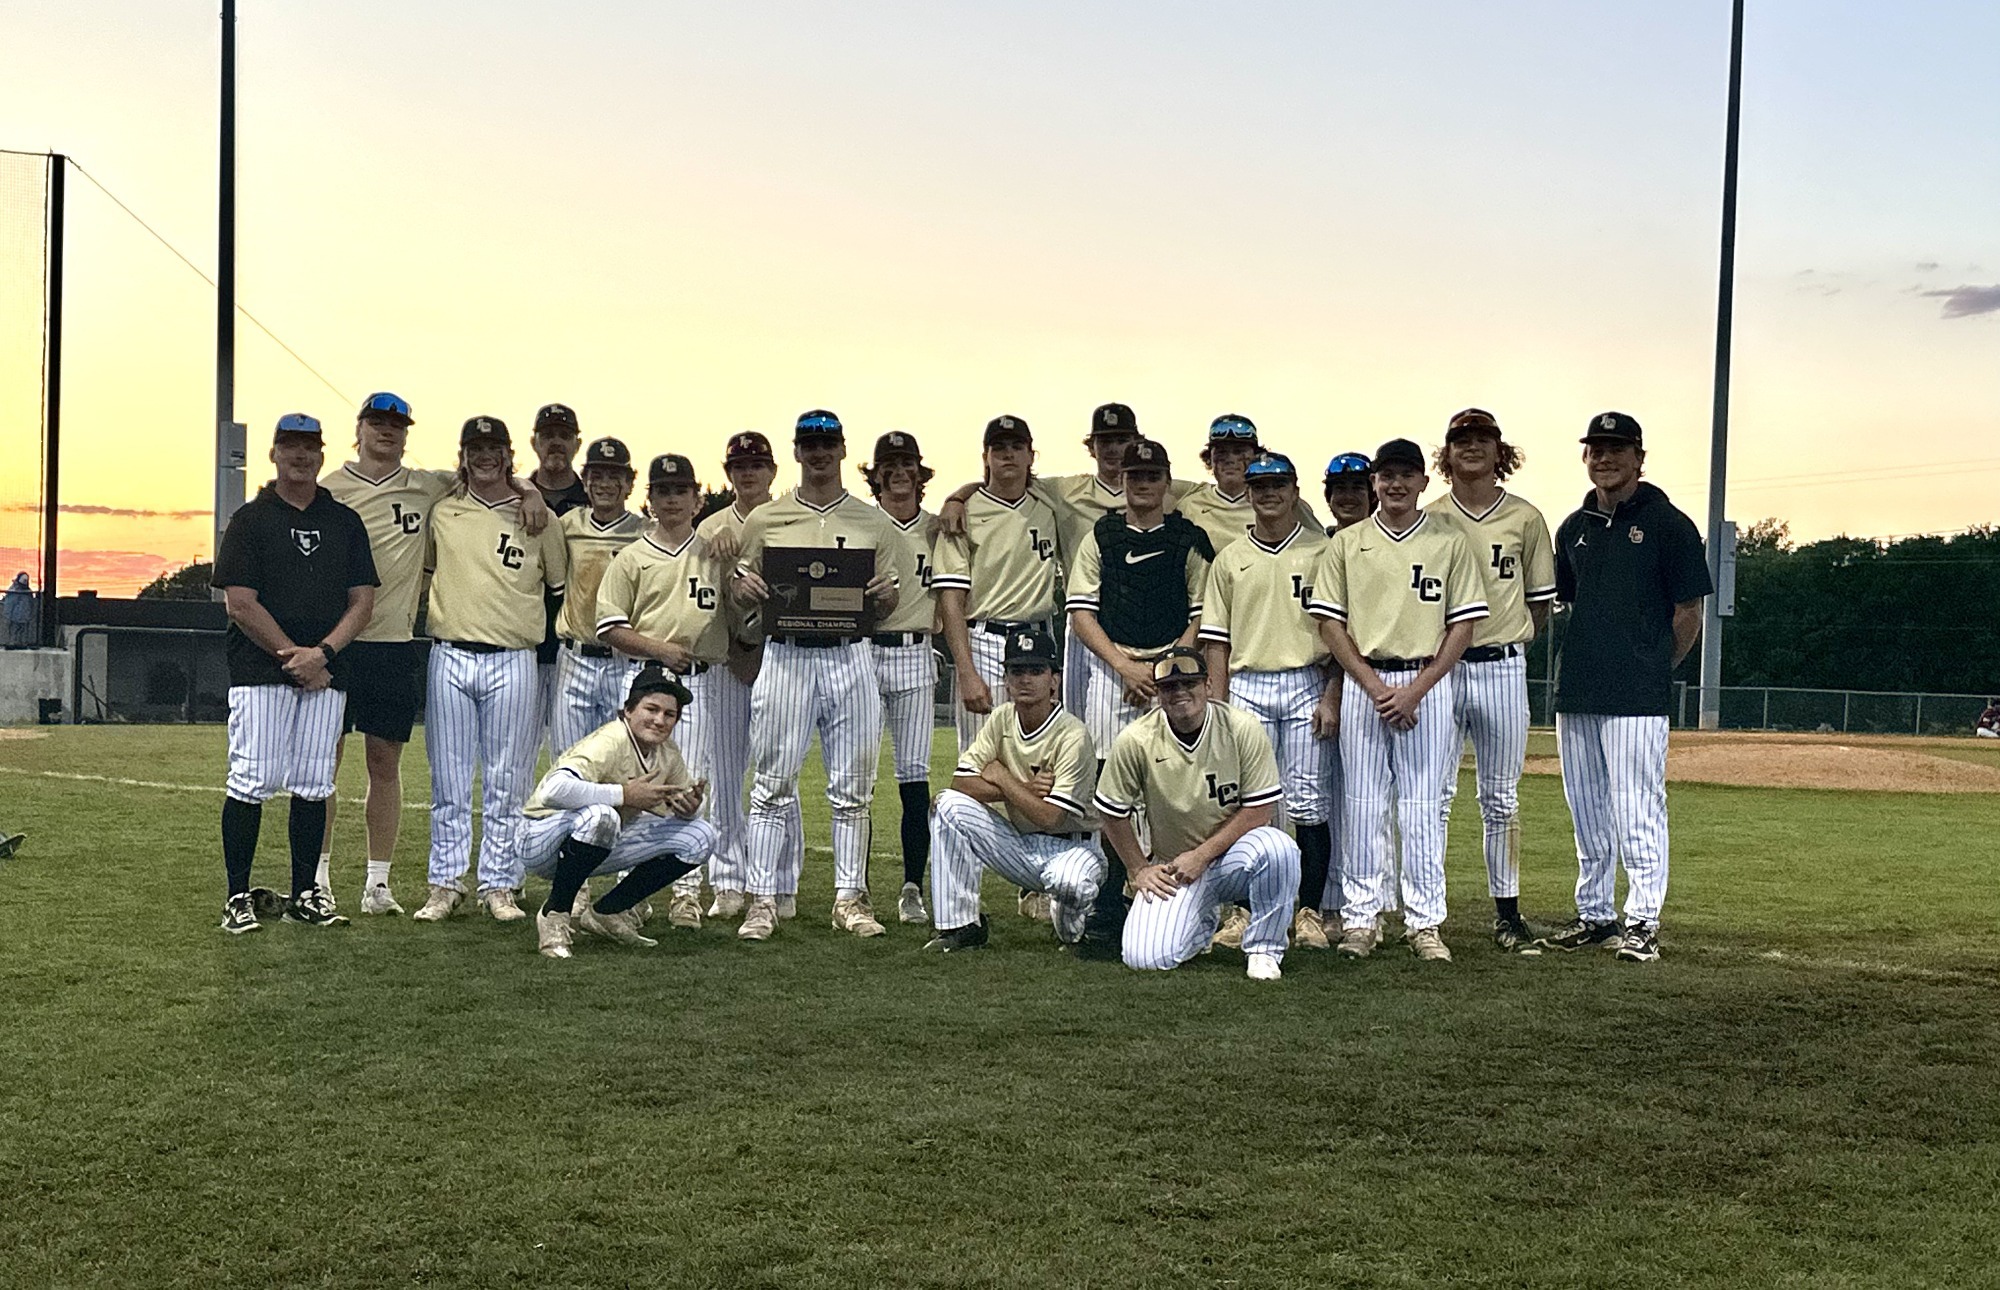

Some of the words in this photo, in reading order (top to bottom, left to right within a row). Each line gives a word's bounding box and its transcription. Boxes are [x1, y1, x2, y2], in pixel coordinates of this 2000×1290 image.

[392, 503, 420, 534] IC
[497, 532, 524, 570] IC
[1030, 529, 1054, 561] IC
[1491, 545, 1516, 579] IC
[689, 577, 716, 610] IC
[1411, 565, 1442, 602] IC
[777, 620, 815, 628] REGIONAL
[817, 621, 858, 629] CHAMPION
[1206, 774, 1238, 807] IC
